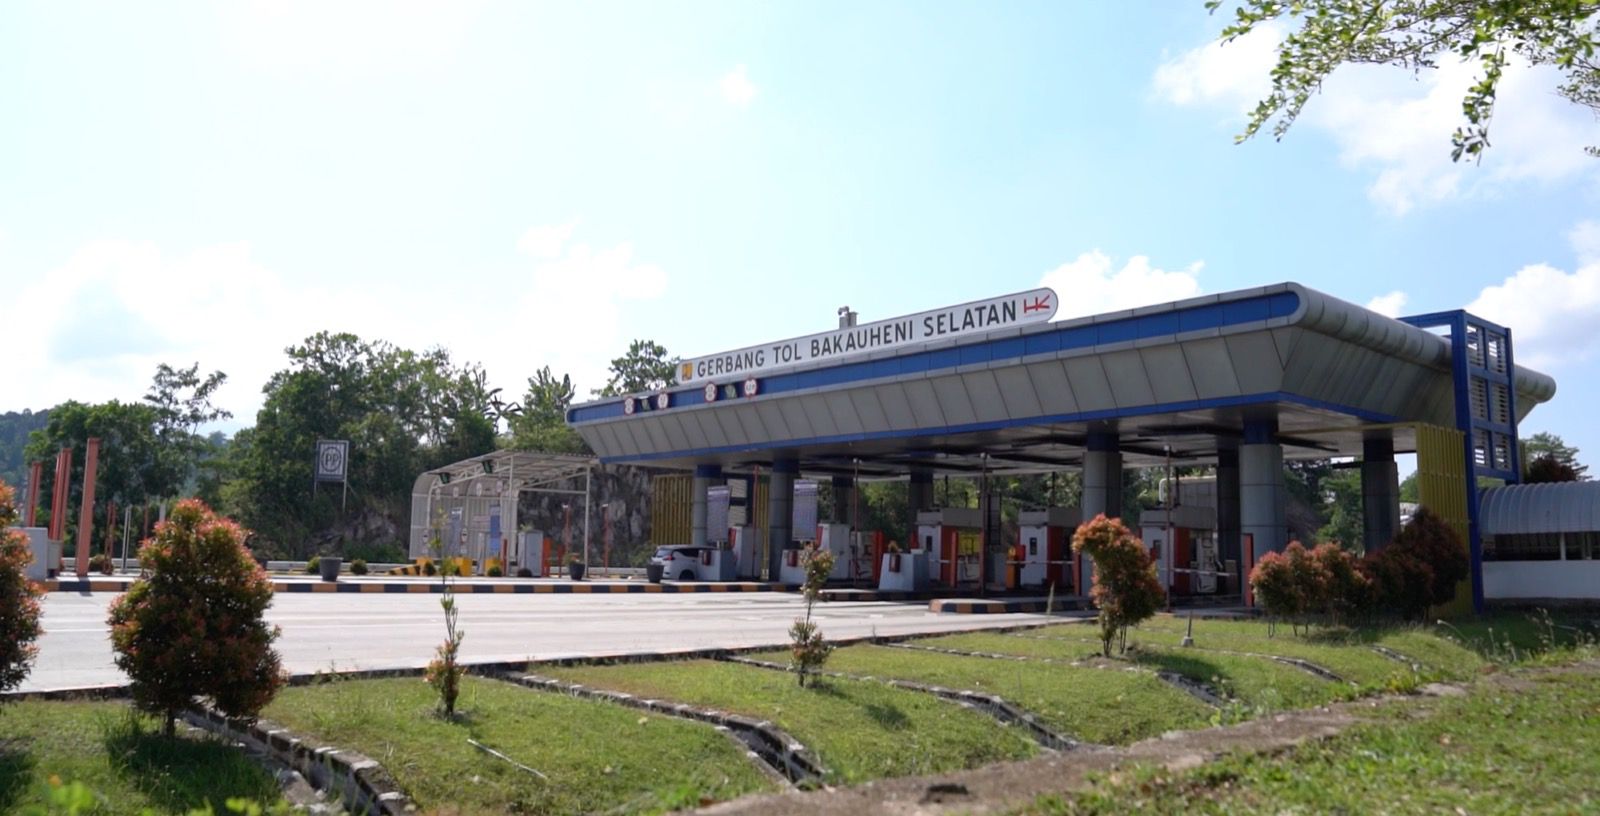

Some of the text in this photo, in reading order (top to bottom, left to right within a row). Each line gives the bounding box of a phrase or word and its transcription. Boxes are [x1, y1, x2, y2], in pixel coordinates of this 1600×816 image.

[1024, 294, 1050, 314] HK
[697, 300, 1016, 377] GERBANG TOL BAKAUHENI SELATAN
